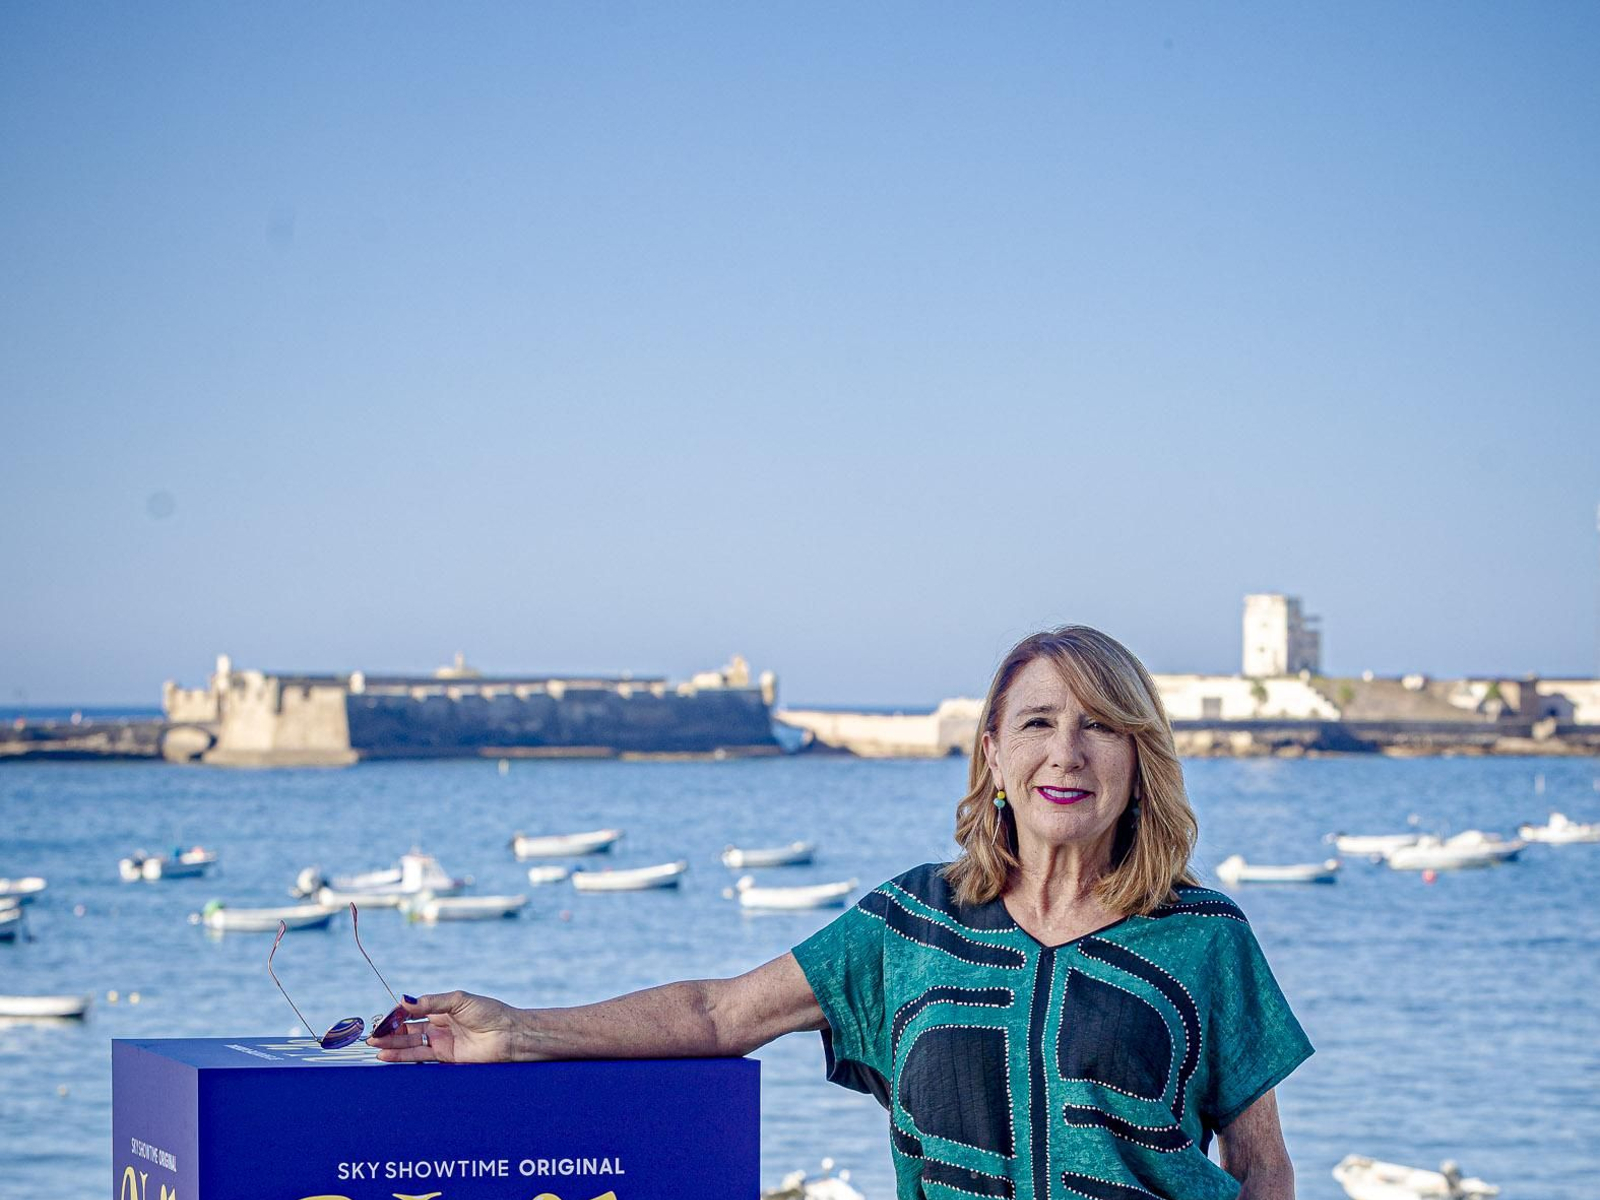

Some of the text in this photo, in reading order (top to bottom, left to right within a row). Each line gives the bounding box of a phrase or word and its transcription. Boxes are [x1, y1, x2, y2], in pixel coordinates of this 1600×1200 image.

[337, 1157, 626, 1180] SKY SHOWTIME ORIGINAL
